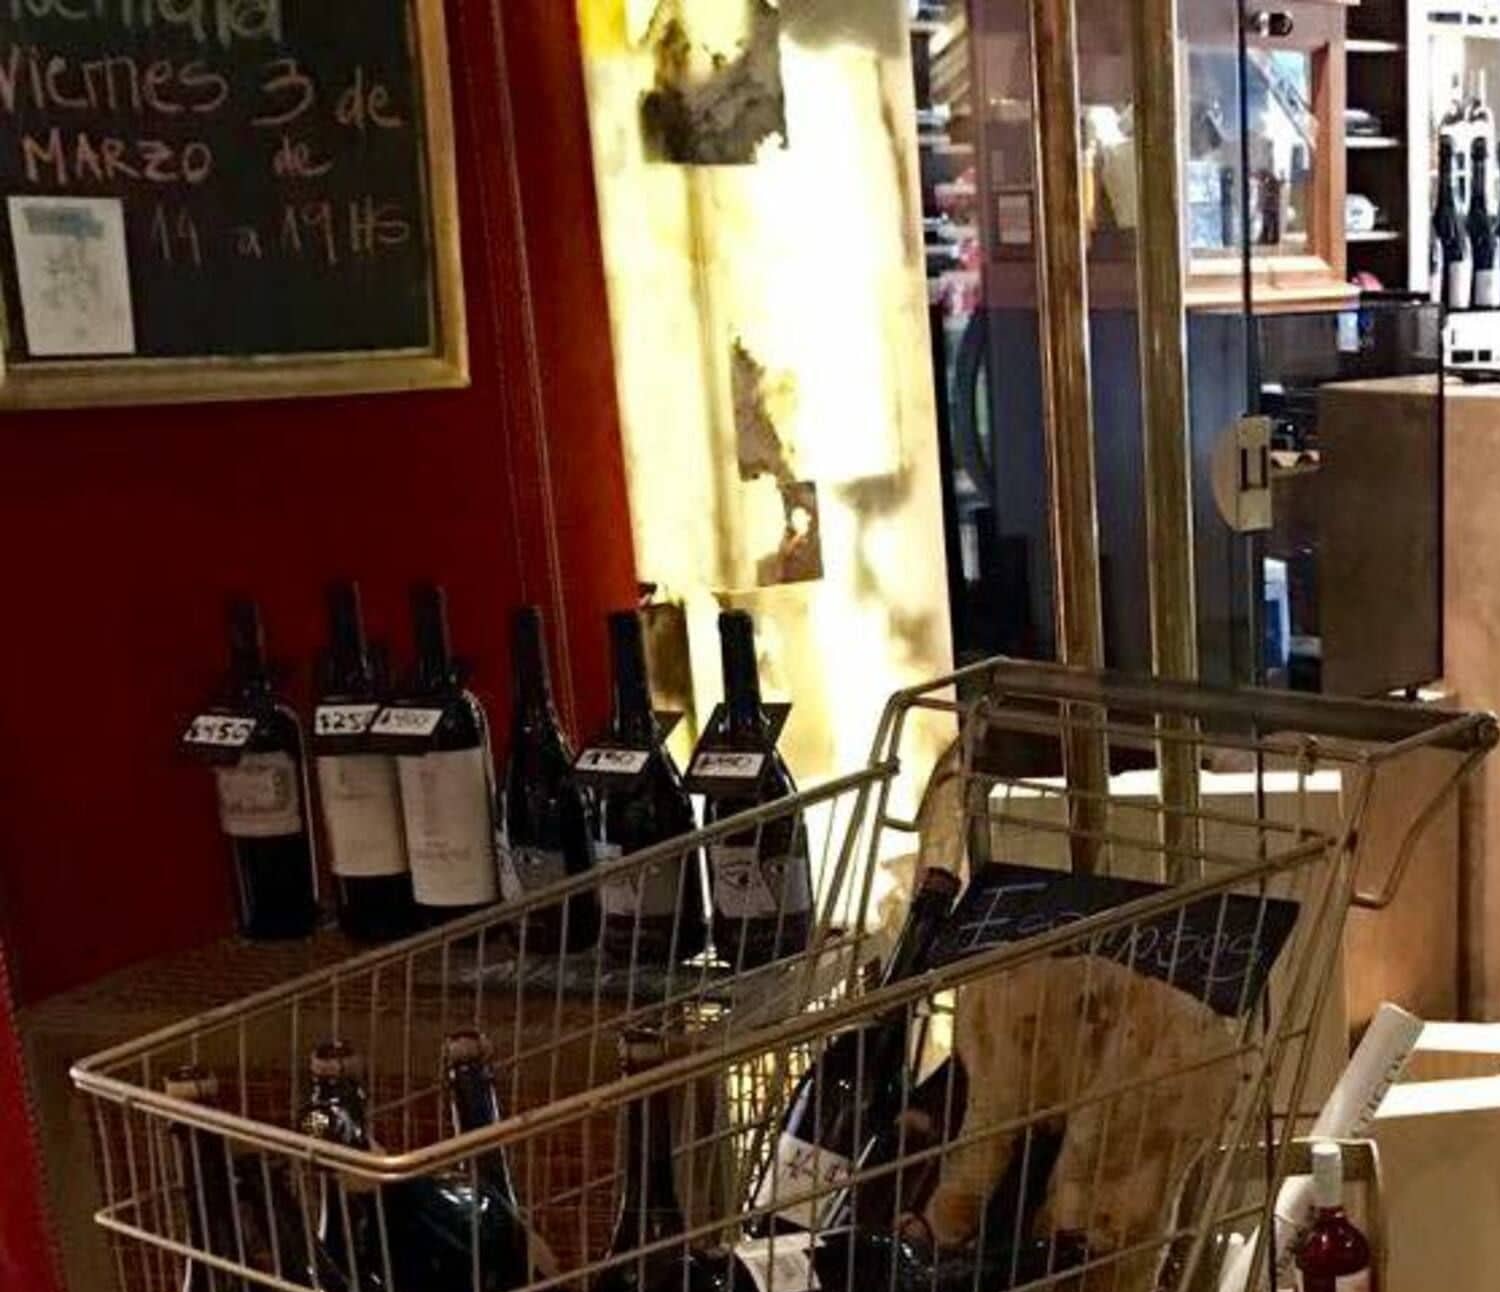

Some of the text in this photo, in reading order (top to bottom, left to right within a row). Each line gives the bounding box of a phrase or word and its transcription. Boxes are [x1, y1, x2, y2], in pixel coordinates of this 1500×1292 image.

[250, 56, 315, 127] 3
[335, 65, 409, 130] de
[21, 127, 335, 185] MARZO de
[150, 204, 201, 266] 14
[283, 202, 337, 266] 19
